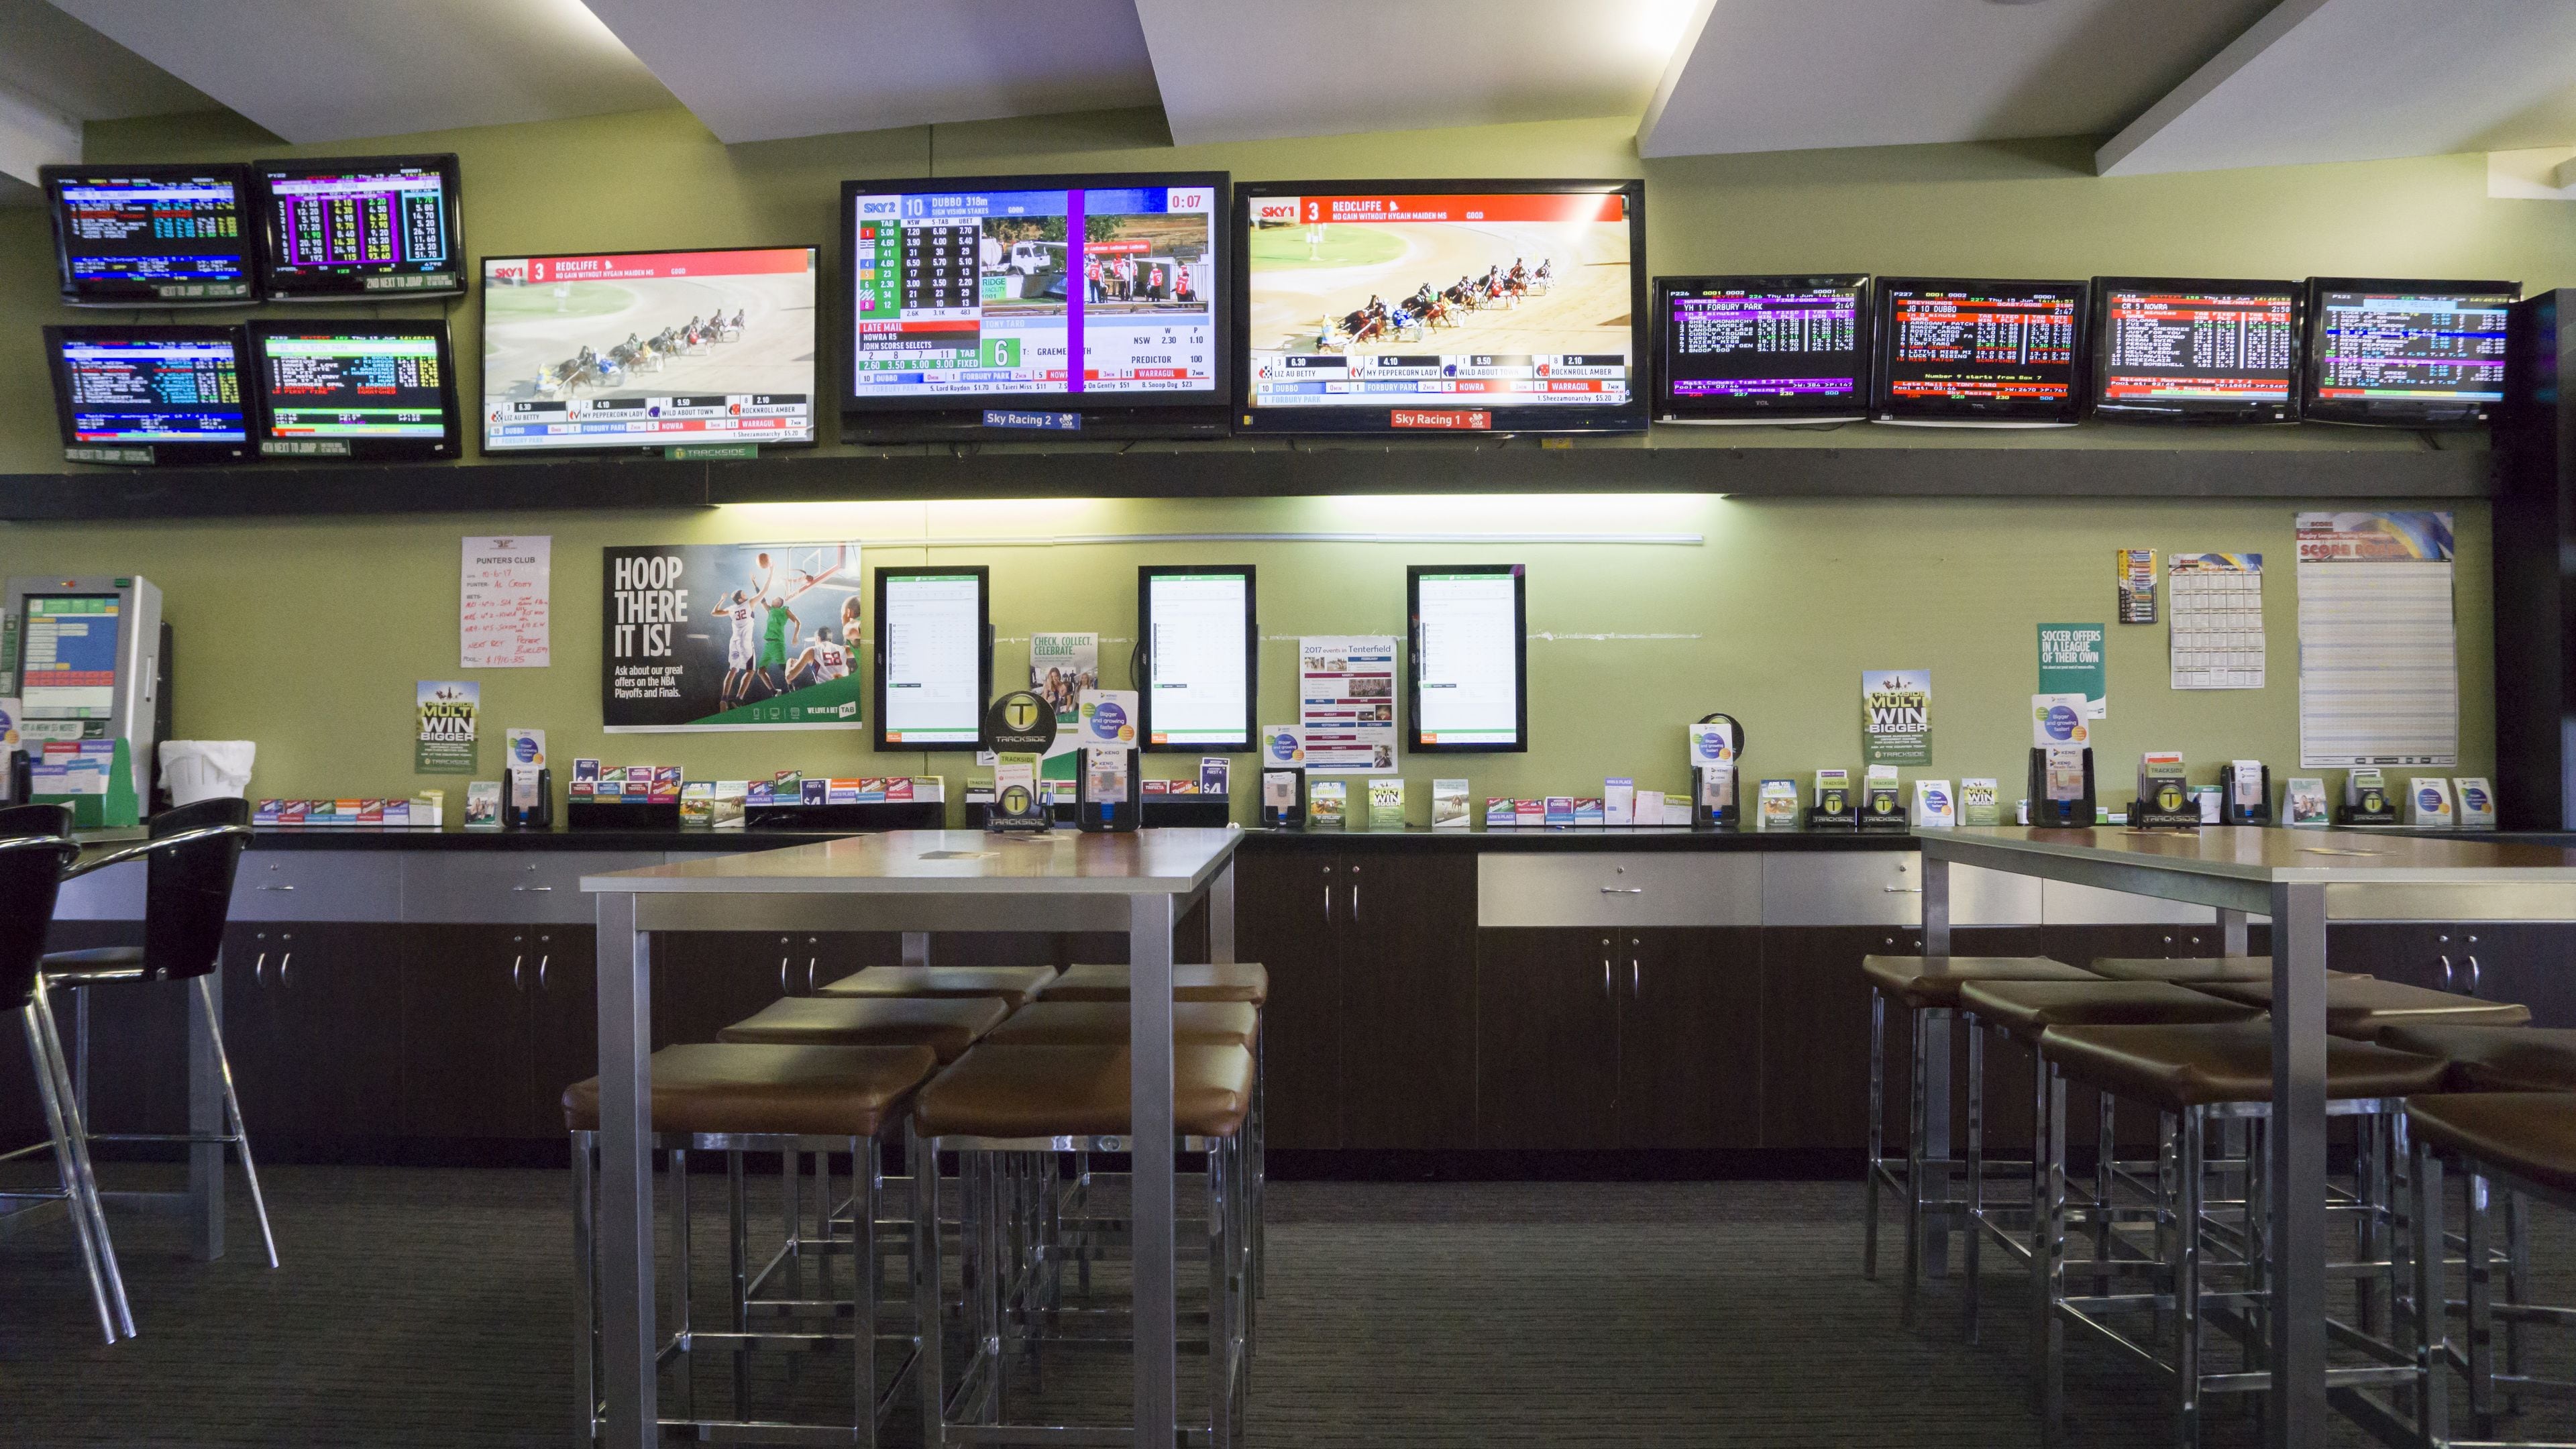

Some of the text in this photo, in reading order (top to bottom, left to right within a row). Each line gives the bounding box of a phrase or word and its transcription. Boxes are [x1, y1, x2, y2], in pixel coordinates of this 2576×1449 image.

[906, 199, 923, 215] 10
[932, 197, 987, 207] DUBBO 318m
[1173, 195, 1201, 208] 0:07
[1333, 201, 1381, 211] REDCLIFFE
[1262, 207, 1293, 217] SKY1
[1309, 203, 1318, 220] 3
[496, 262, 597, 279] SKY1 3 REDCLIFFE
[366, 276, 422, 288] 2ND NEXT TO JUMP
[883, 323, 902, 331] MAIL
[995, 340, 1008, 366] 6
[1139, 369, 1175, 377] WARRAGUL
[1552, 382, 1589, 390] WARRAGUL
[987, 413, 1051, 426] Sky Racing 2
[1395, 413, 1460, 426] Sky Racing 1
[615, 557, 683, 590] HOOP
[614, 590, 688, 623] THERE
[735, 609, 746, 620] 32
[614, 624, 671, 657] IT IS!
[1034, 637, 1092, 645] CHECK. COLLECT.
[2042, 631, 2100, 641] SOCCER OFFERS
[1034, 646, 1075, 655] CELEBRATE.
[2043, 641, 2090, 651] IN A LEAGUE
[823, 652, 841, 666] 58
[2043, 652, 2098, 662] OF THEIR OWN
[615, 666, 627, 675] Ask
[629, 666, 649, 674] about
[665, 665, 683, 676] great
[615, 677, 635, 686] offers
[648, 677, 659, 686] the
[661, 677, 675, 686] NBA
[615, 688, 680, 699] Playoffs and Finals.
[1869, 697, 1926, 707] MULTI
[421, 708, 476, 717] MULTI
[1870, 707, 1927, 724] WIN
[422, 717, 474, 733] WIN
[1870, 724, 1927, 733] BIGGER
[421, 733, 474, 741] BIGGER
